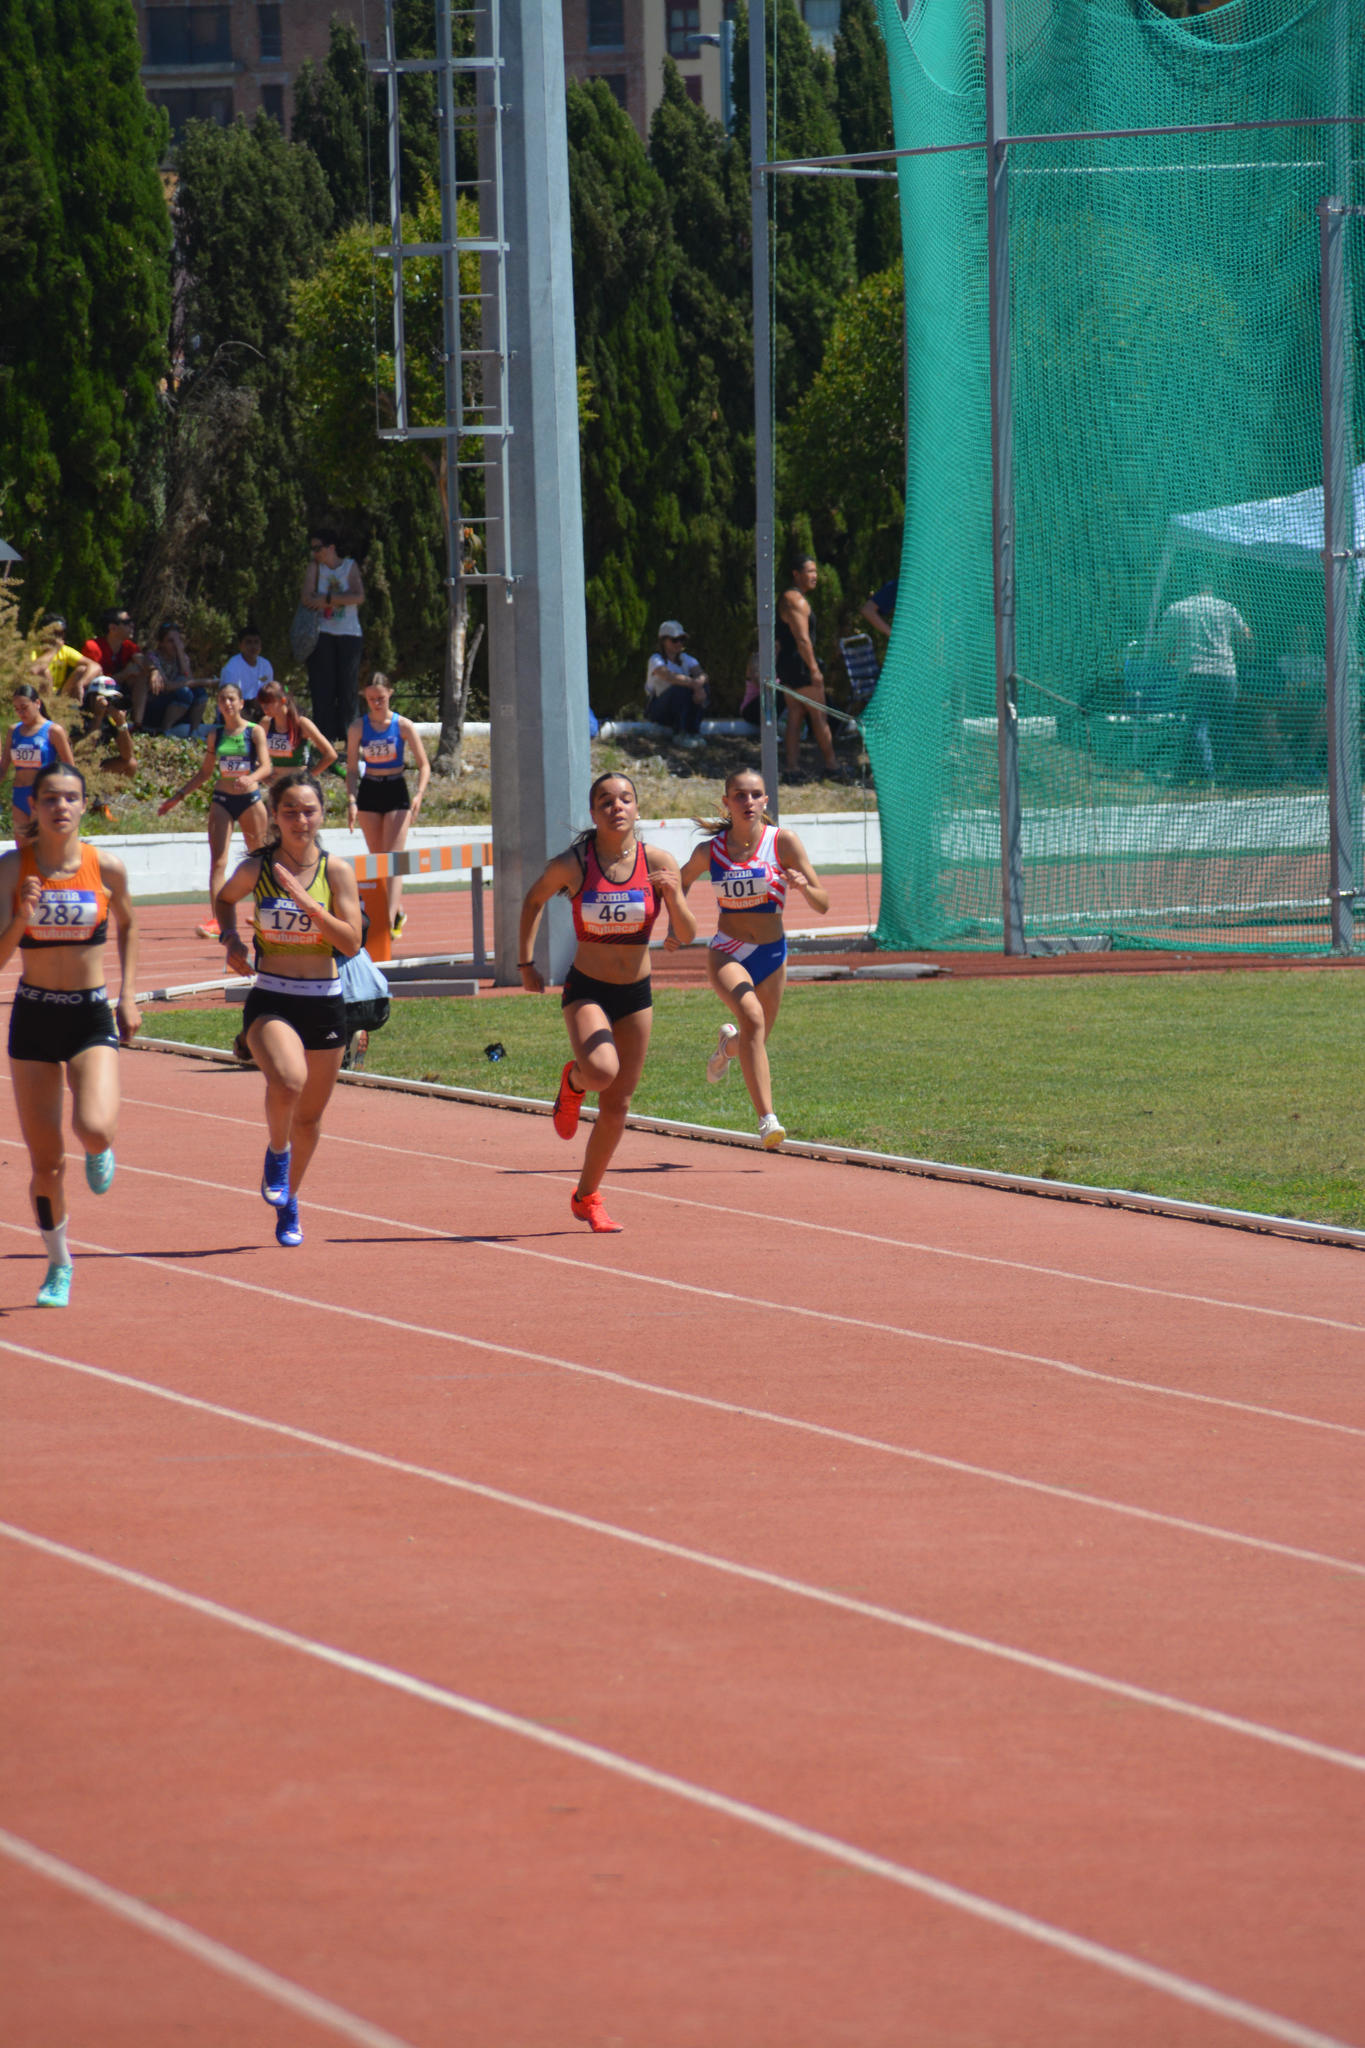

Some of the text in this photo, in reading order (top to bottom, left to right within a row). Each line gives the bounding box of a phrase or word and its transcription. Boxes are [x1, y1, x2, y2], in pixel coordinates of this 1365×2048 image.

[270, 740, 287, 751] 156
[16, 750, 35, 760] 307
[227, 761, 241, 771] 87
[721, 880, 757, 898] 101
[39, 904, 84, 926] 282
[599, 904, 627, 923] 46
[271, 911, 312, 932] 179
[43, 992, 83, 1004] PRO
